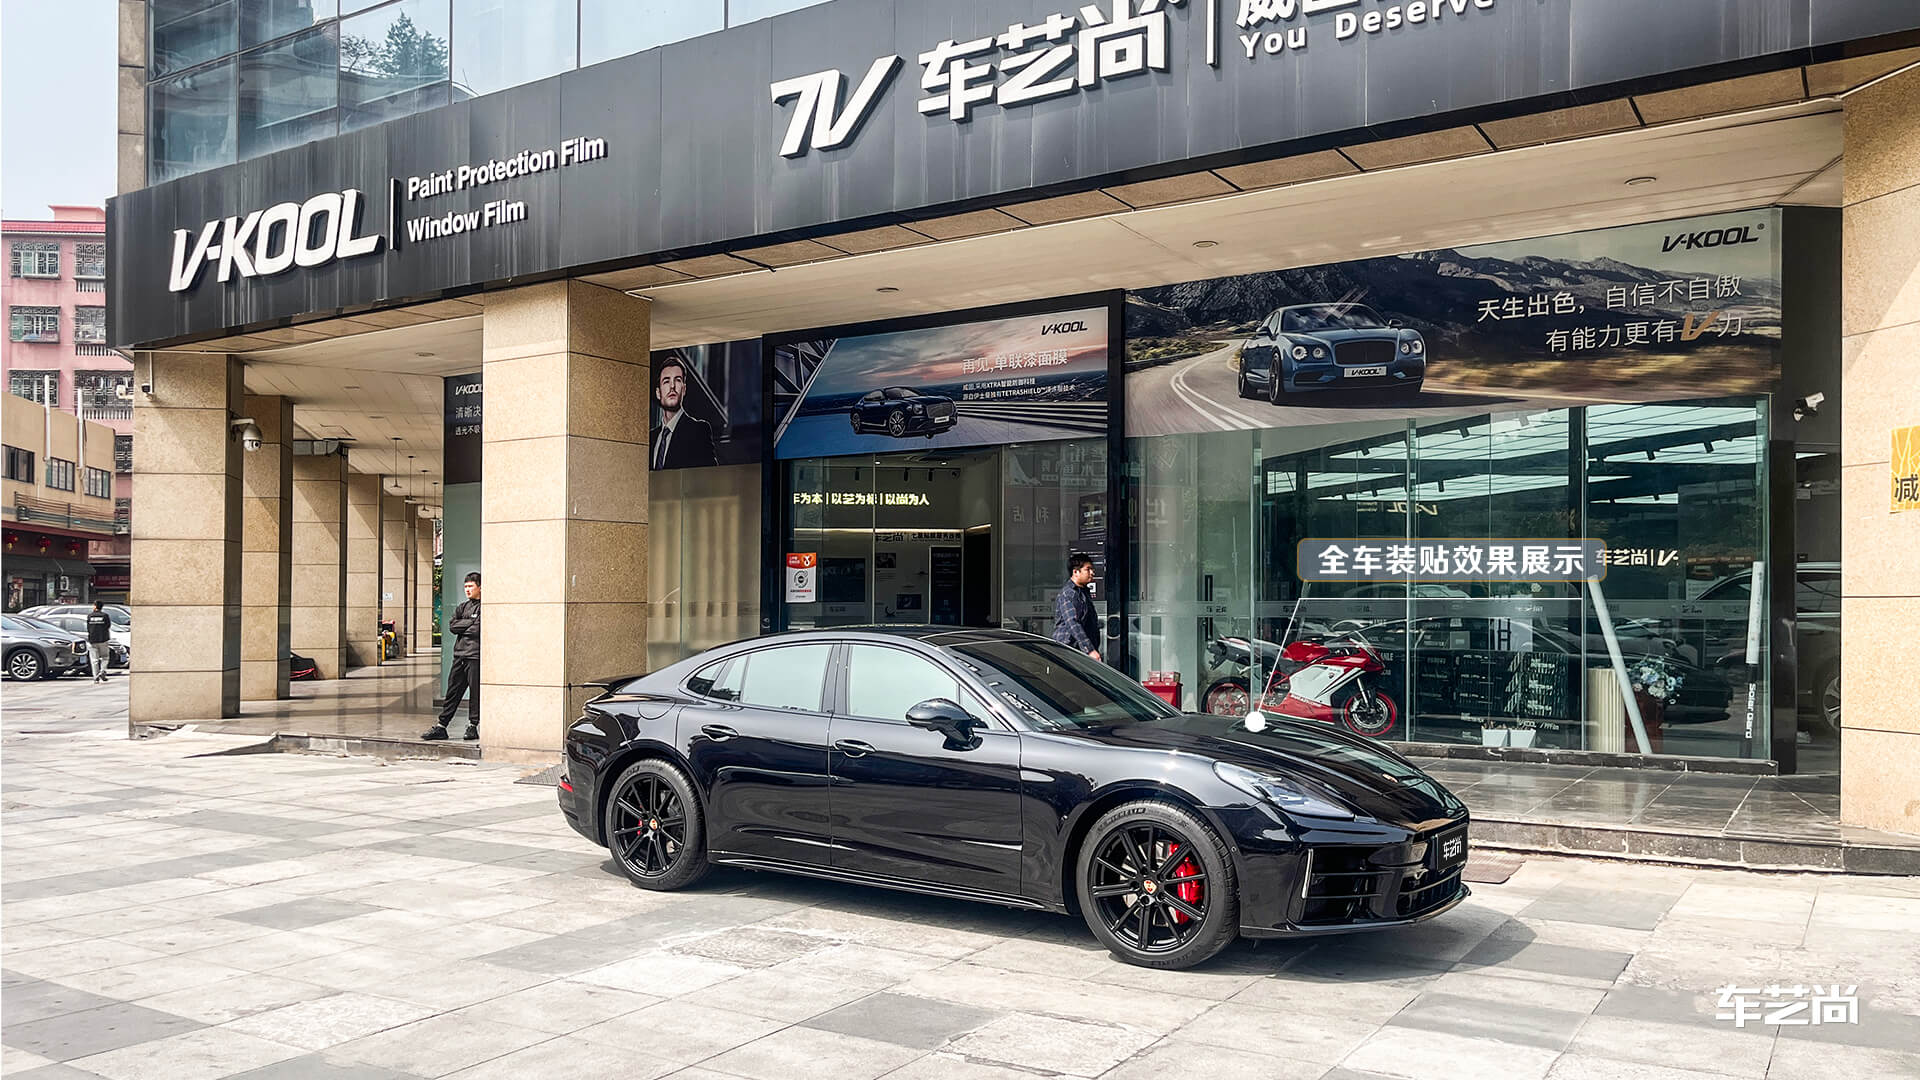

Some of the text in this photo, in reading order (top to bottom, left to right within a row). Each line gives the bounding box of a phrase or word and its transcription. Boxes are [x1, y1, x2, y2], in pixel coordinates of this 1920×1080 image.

[917, 0, 1170, 121] 车艺尚
[1239, 26, 1306, 58] You
[408, 136, 608, 202] Paint Protection Film
[168, 189, 382, 293] V-KOOL
[406, 200, 527, 244] Window Film
[1041, 320, 1088, 336] V-KOOL
[1894, 474, 1920, 503] 减
[1595, 548, 1648, 567] 车艺尚
